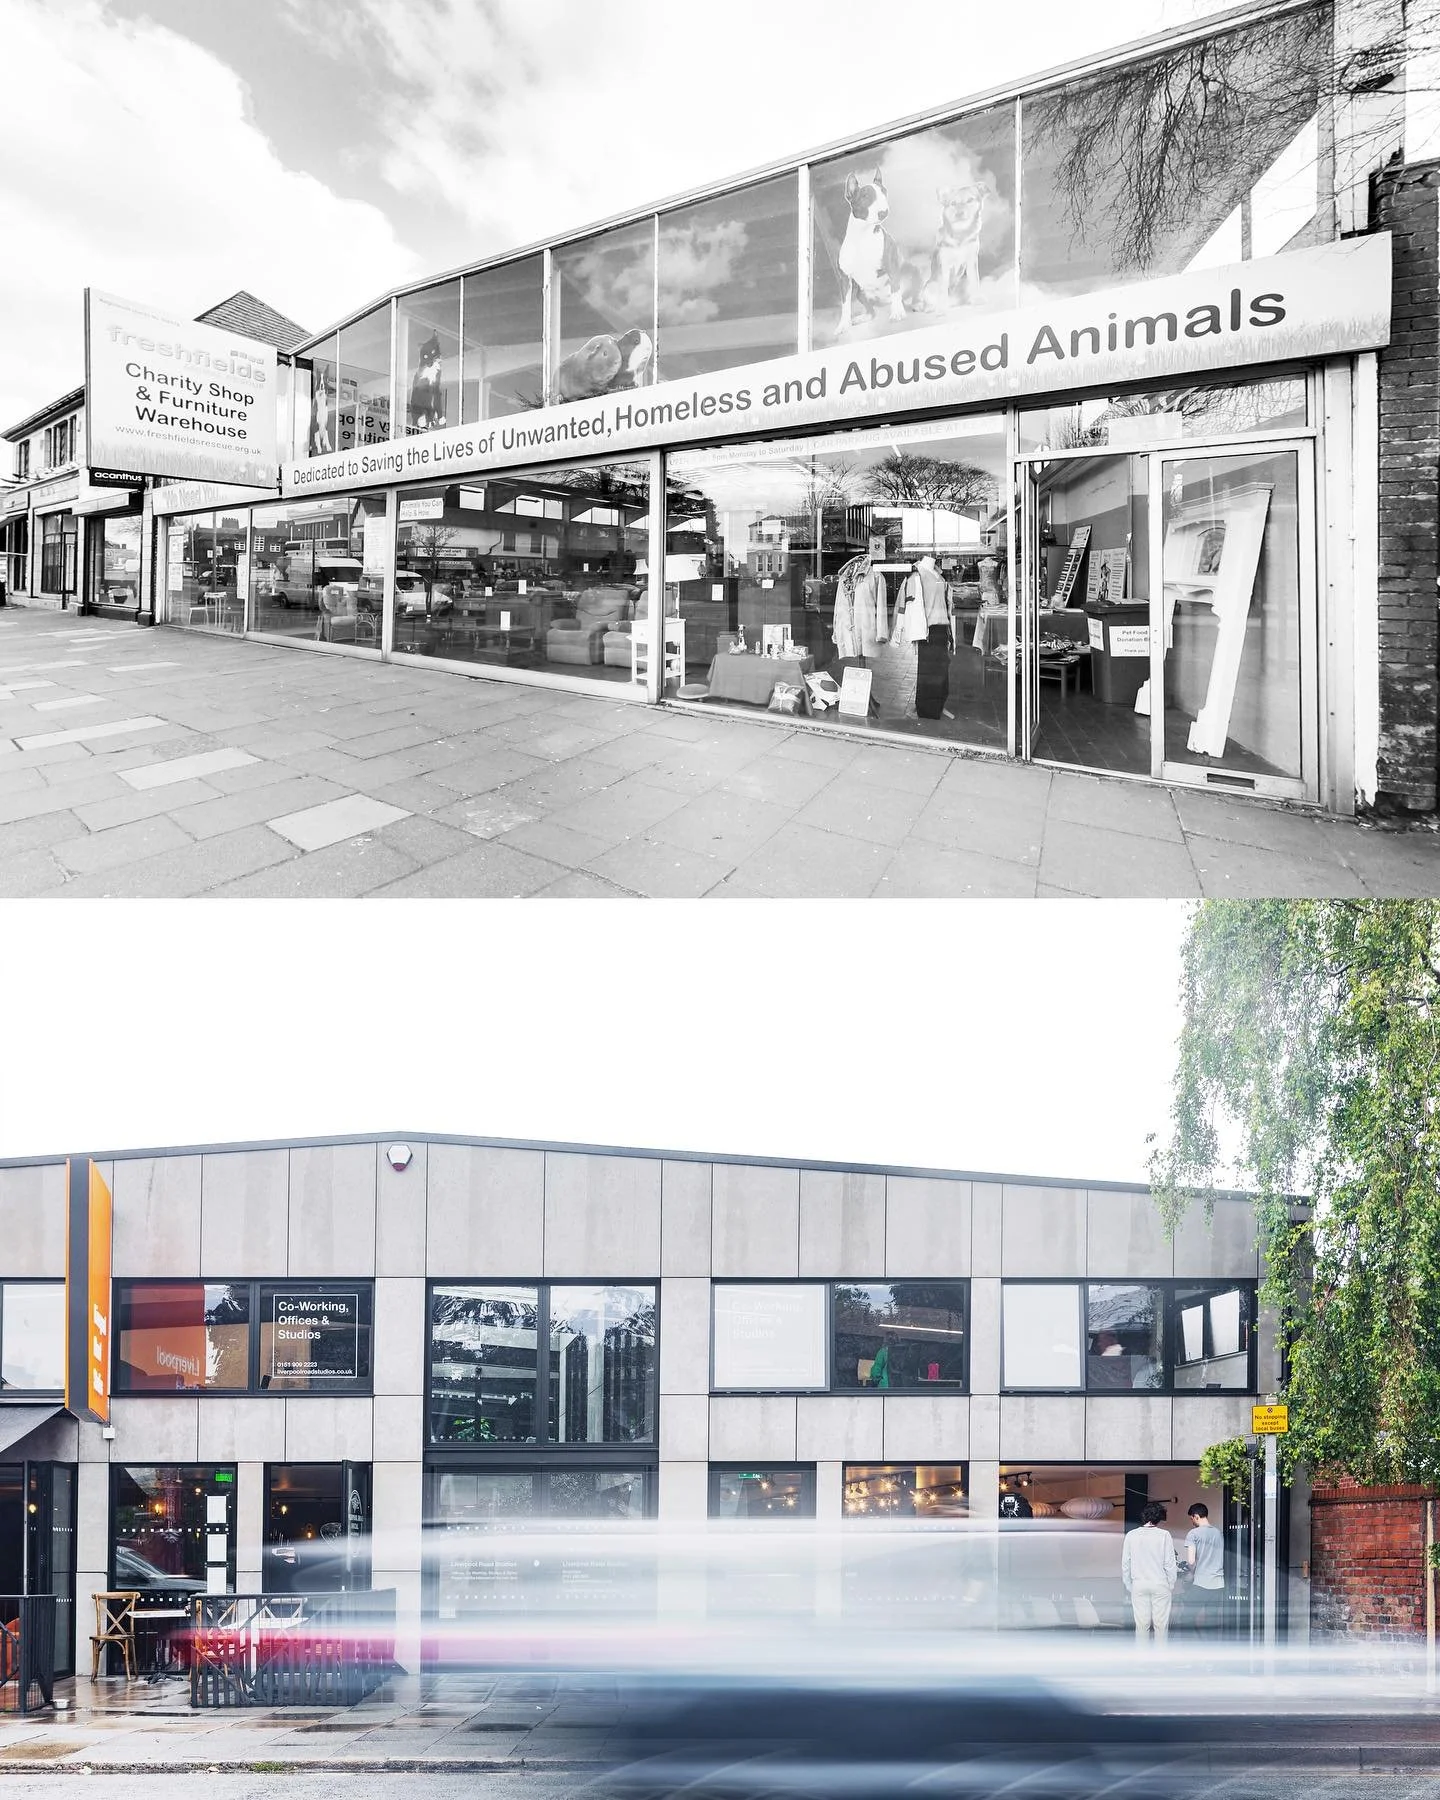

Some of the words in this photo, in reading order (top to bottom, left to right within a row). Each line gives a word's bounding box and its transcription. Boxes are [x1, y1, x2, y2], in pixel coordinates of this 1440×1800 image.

[107, 325, 267, 383] freshfields
[125, 362, 203, 396] Charity
[209, 382, 255, 408] Shop
[293, 461, 345, 485] Dedicated
[348, 460, 359, 476] to
[361, 454, 403, 474] Saving
[407, 447, 430, 466] the
[433, 441, 474, 462] Lives
[478, 431, 496, 454] of
[762, 367, 827, 407] and
[839, 332, 1008, 395] Abused
[1026, 288, 1287, 365] Animals
[135, 385, 153, 402] &
[159, 390, 247, 422] Furniture
[135, 404, 248, 440] Warehouse
[115, 424, 262, 456] www.freshfieldsrescue.org.uk
[768, 444, 804, 456] Saturday
[94, 471, 143, 482] acanthus
[278, 1301, 349, 1313] Co-Working,
[278, 1315, 319, 1326] Offices
[321, 1315, 330, 1326] &
[278, 1329, 321, 1340] Studios
